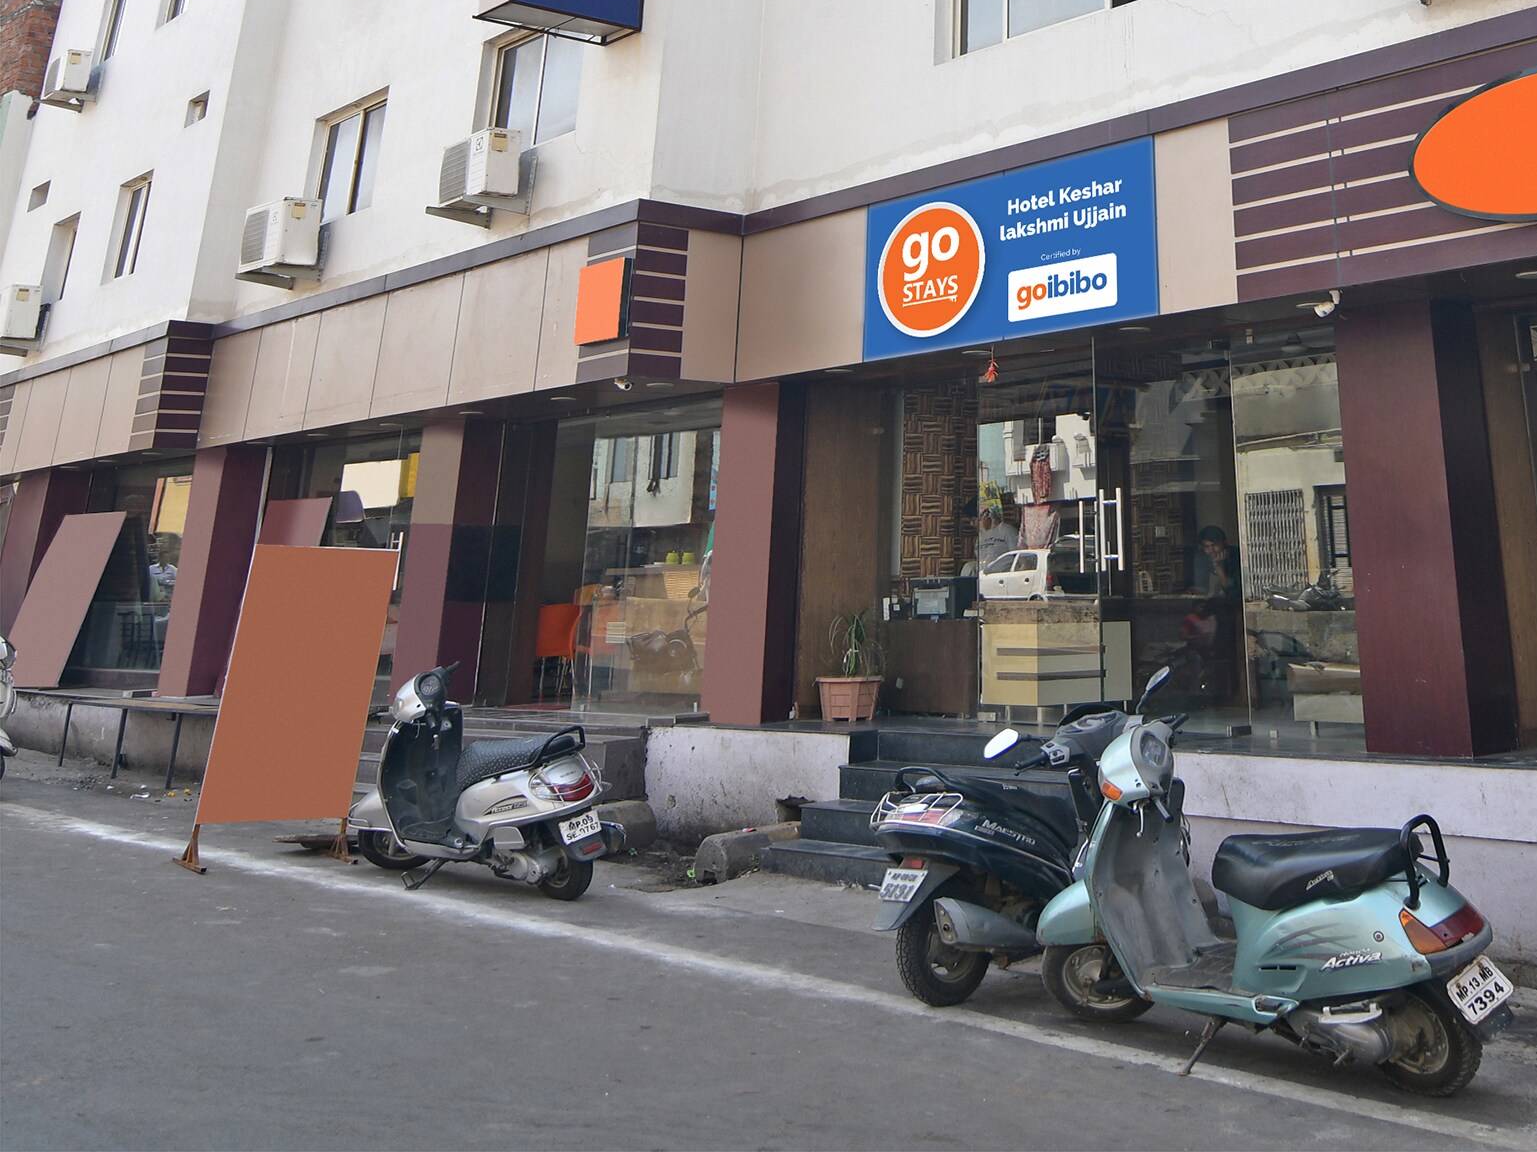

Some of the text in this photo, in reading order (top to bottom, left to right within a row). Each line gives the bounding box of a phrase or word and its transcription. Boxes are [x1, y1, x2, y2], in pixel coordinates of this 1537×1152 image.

[1007, 178, 1123, 216] Hotel Keshar
[1000, 202, 1127, 241] lakshmi Ujjain
[902, 226, 960, 281] go
[1040, 248, 1082, 262] Certified by
[903, 275, 959, 300] STAYS
[1016, 270, 1107, 310] goibibo
[1320, 951, 1382, 972] Activa
[1467, 982, 1505, 1015] 7394
